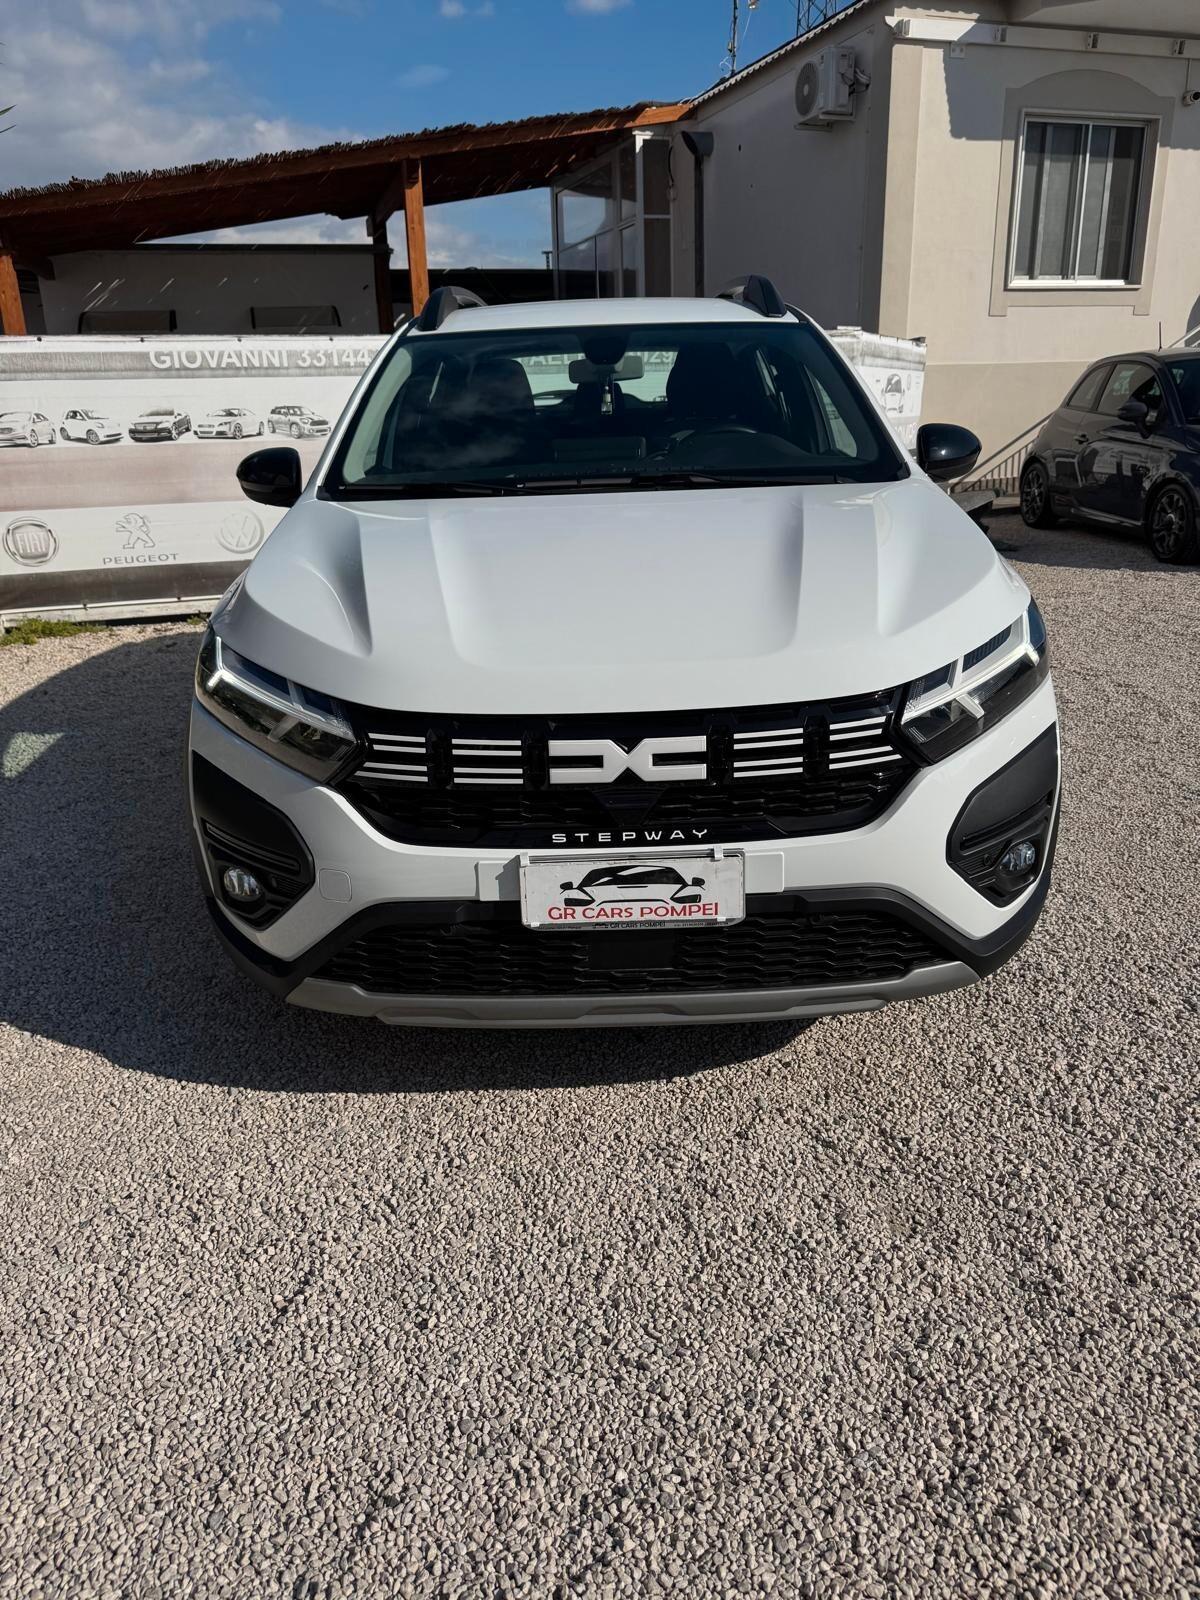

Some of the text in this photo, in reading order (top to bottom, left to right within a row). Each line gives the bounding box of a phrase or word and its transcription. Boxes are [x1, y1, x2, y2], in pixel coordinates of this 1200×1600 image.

[150, 349, 373, 369] GIOVANNI 33144
[16, 531, 48, 553] FIAT
[102, 552, 180, 566] PEUGEOT
[551, 828, 708, 843] STEPWAY
[547, 902, 719, 920] GR CARS POMPEI
